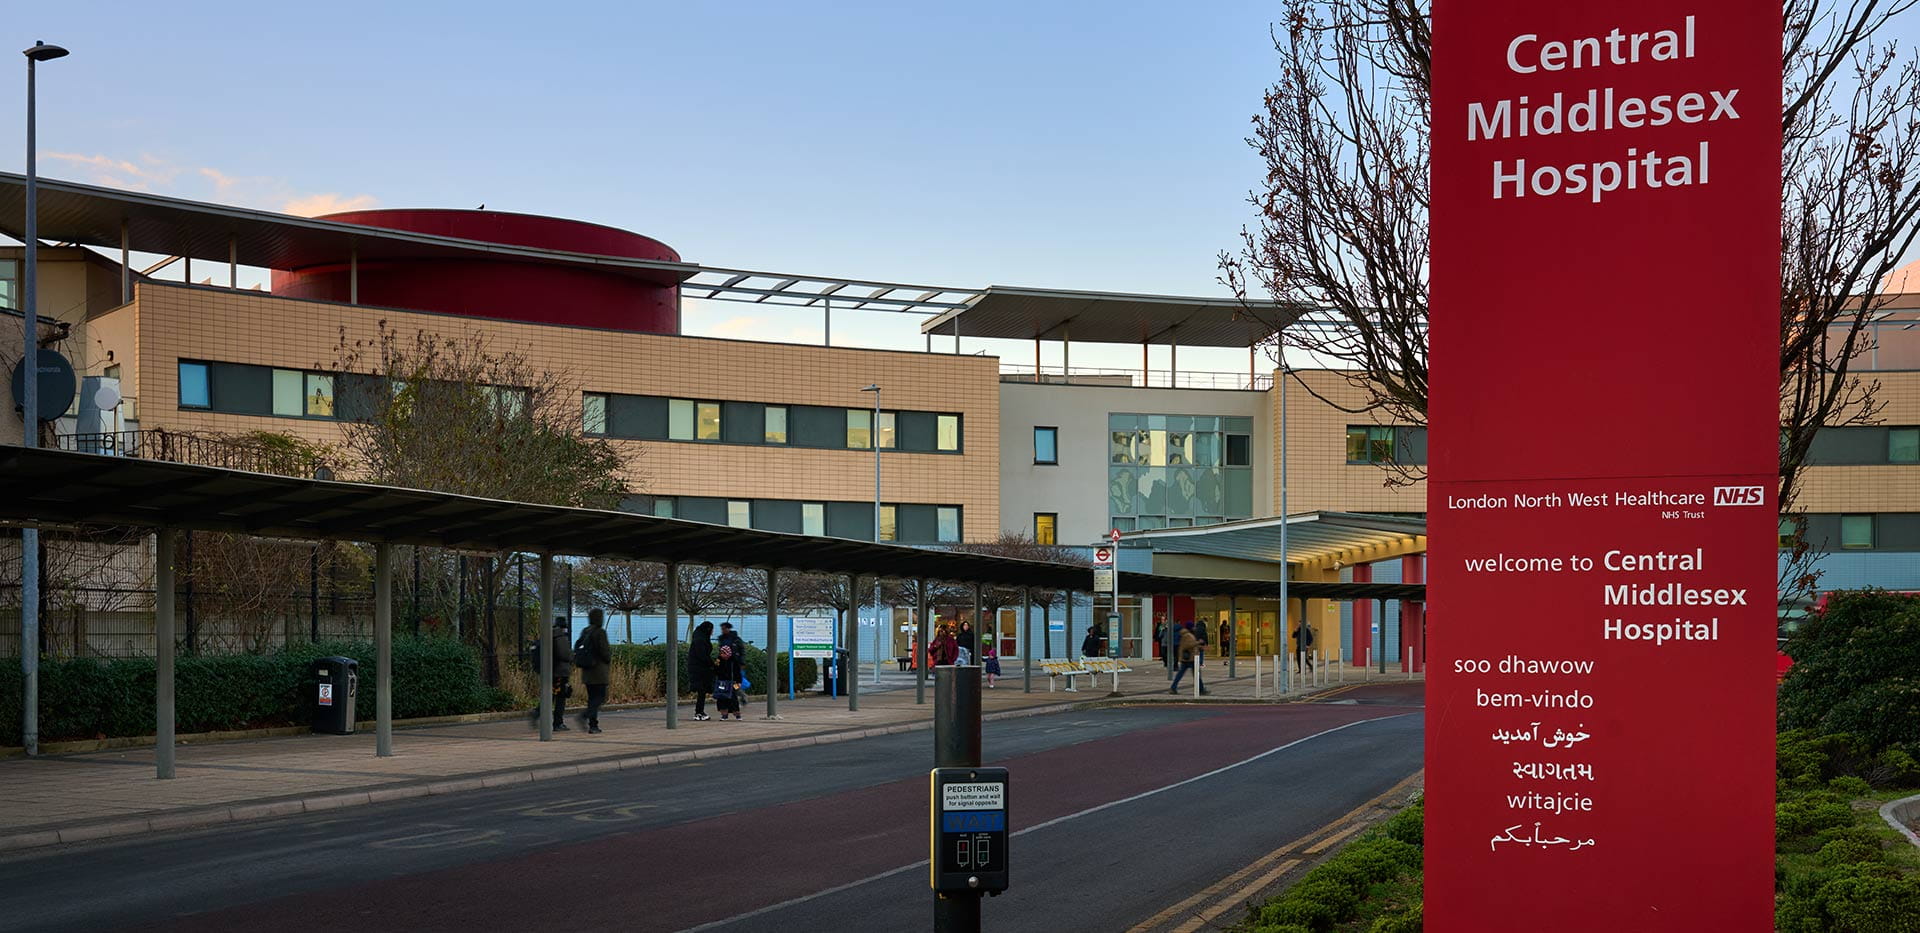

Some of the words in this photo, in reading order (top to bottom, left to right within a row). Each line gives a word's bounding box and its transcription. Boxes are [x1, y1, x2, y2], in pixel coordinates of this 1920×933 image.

[1506, 15, 1695, 74] Central
[1467, 87, 1741, 143] Middlesex
[1493, 141, 1709, 204] Hospital
[1448, 493, 1507, 510] London
[1514, 492, 1562, 508] North
[1567, 492, 1609, 507] West
[1615, 490, 1705, 506] Healthcare
[1715, 487, 1762, 504] NHS
[1661, 510, 1680, 519] NHS
[1682, 510, 1705, 519] Trust
[1112, 530, 1120, 538] A
[1464, 553, 1563, 572] welcome
[1569, 554, 1594, 572] to
[1603, 547, 1703, 572] Central
[1604, 582, 1747, 606] Middlesex
[1604, 617, 1718, 646] Hospital
[1454, 659, 1491, 674] soo
[1498, 654, 1595, 675] dhawow
[1476, 687, 1594, 709] bem-vindo
[1542, 723, 1591, 749] خوش
[1512, 761, 1595, 781] સ્વાગતમ
[1506, 791, 1593, 815] witajcie
[947, 814, 1000, 829] WAIT
